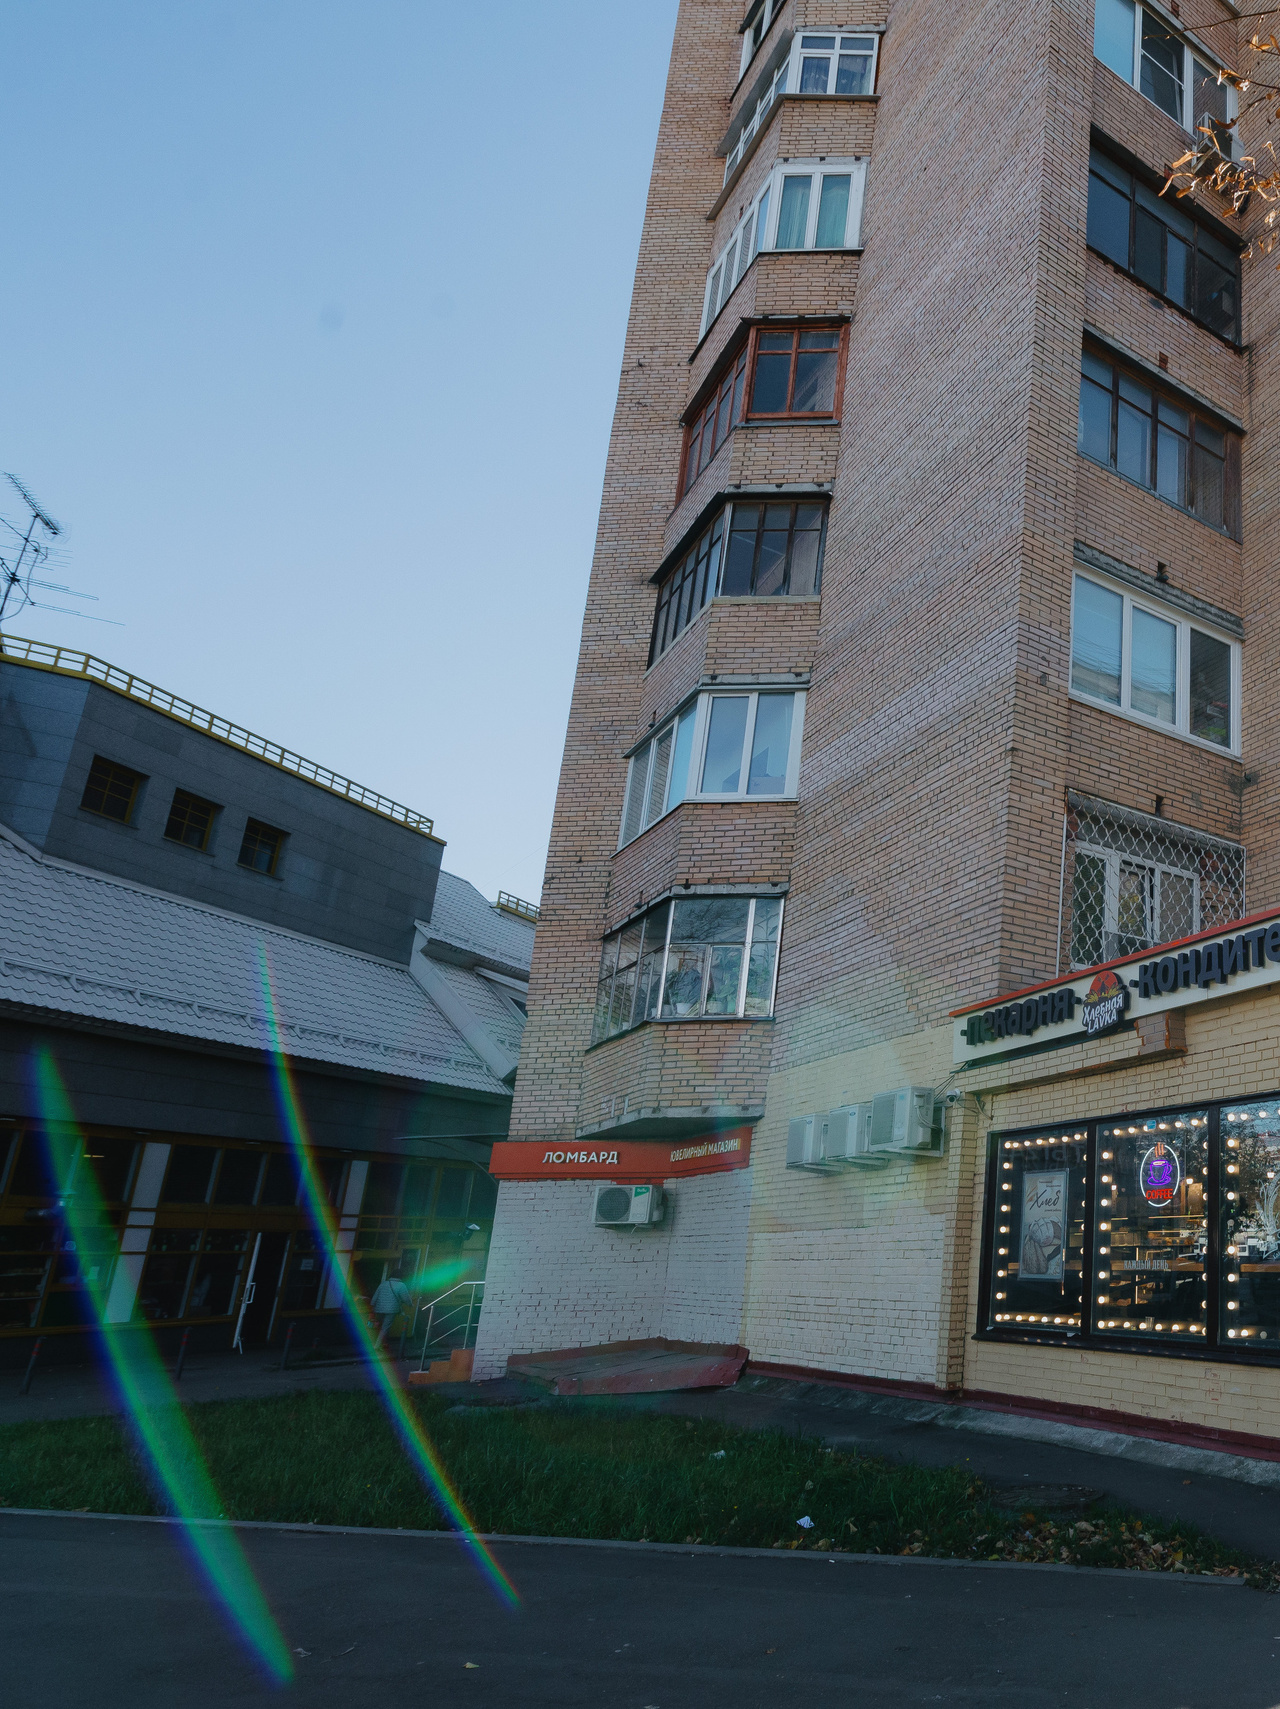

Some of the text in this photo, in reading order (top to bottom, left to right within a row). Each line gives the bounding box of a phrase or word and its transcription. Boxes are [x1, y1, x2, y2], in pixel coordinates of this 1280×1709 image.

[966, 987, 1076, 1047] пекарня
[1089, 1008, 1117, 1033] LAVKA
[542, 1151, 618, 1165] ЛОМБАРД
[670, 1138, 740, 1162] ЮВЕЛИРНЫЙ МАГАЗИН
[1029, 1189, 1062, 1210] Хлеб
[1145, 1188, 1173, 1200] COFFEE
[1123, 1257, 1169, 1270] КАЖДЫЙ ДЕНЬ
